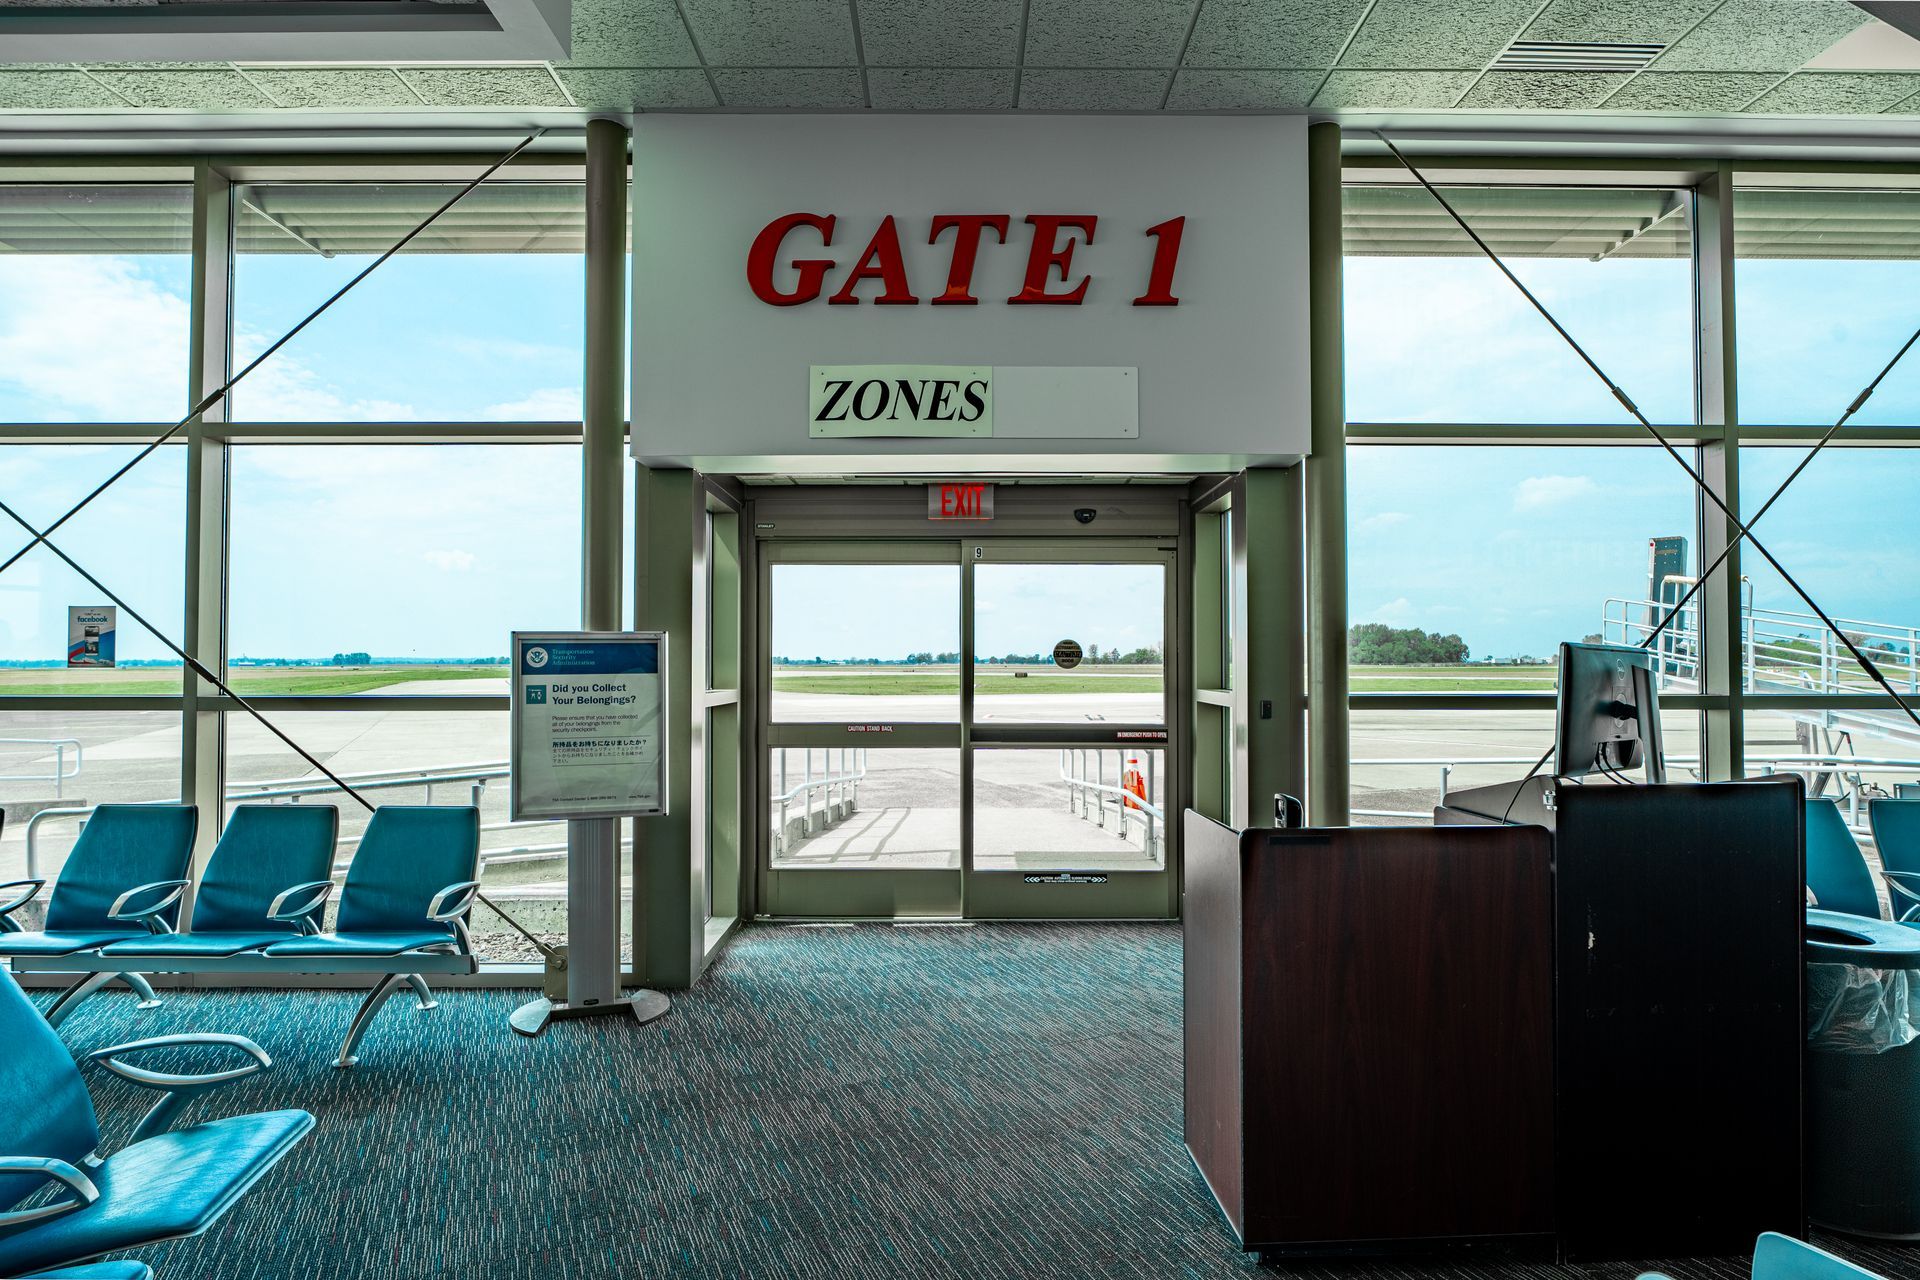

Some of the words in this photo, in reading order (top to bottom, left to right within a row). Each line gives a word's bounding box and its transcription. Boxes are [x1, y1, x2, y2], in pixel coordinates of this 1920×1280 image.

[746, 212, 1098, 306] GATE
[1132, 215, 1186, 306] 1
[815, 378, 989, 422] ZONES
[940, 486, 986, 517] EXIT
[975, 547, 983, 558] 9
[572, 686, 588, 694] you
[592, 684, 626, 692] Collect
[552, 696, 574, 705] Your
[577, 695, 636, 706] Belongings?
